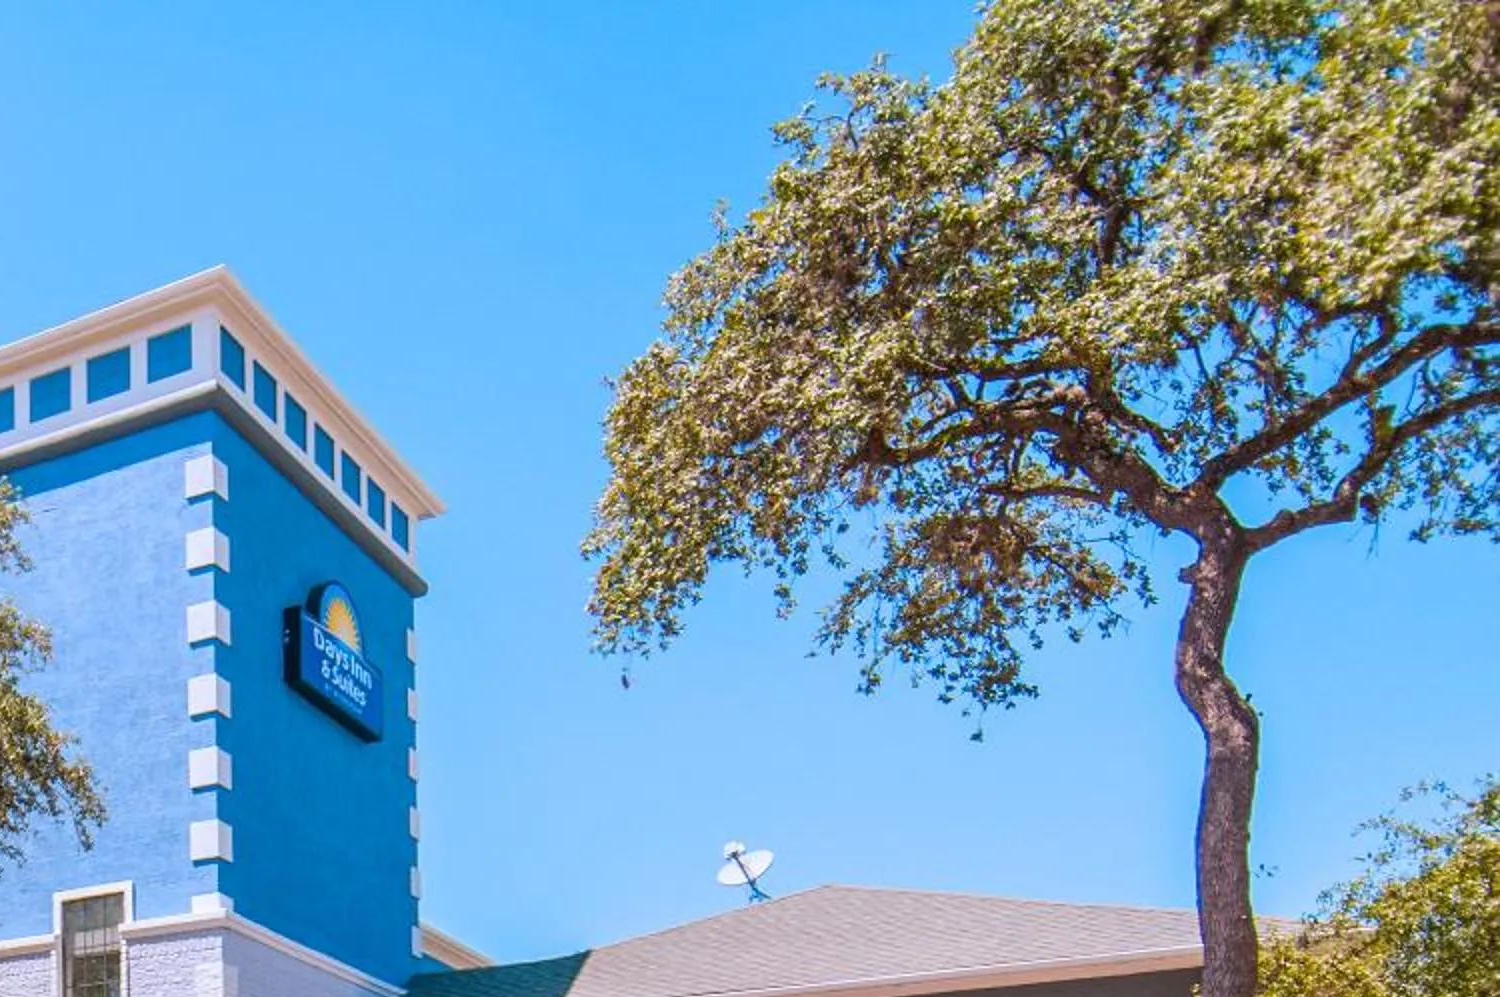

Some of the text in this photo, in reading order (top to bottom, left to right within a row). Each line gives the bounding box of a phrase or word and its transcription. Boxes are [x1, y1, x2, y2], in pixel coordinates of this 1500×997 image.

[313, 627, 372, 689] Days Inn
[332, 666, 366, 706] Suites
